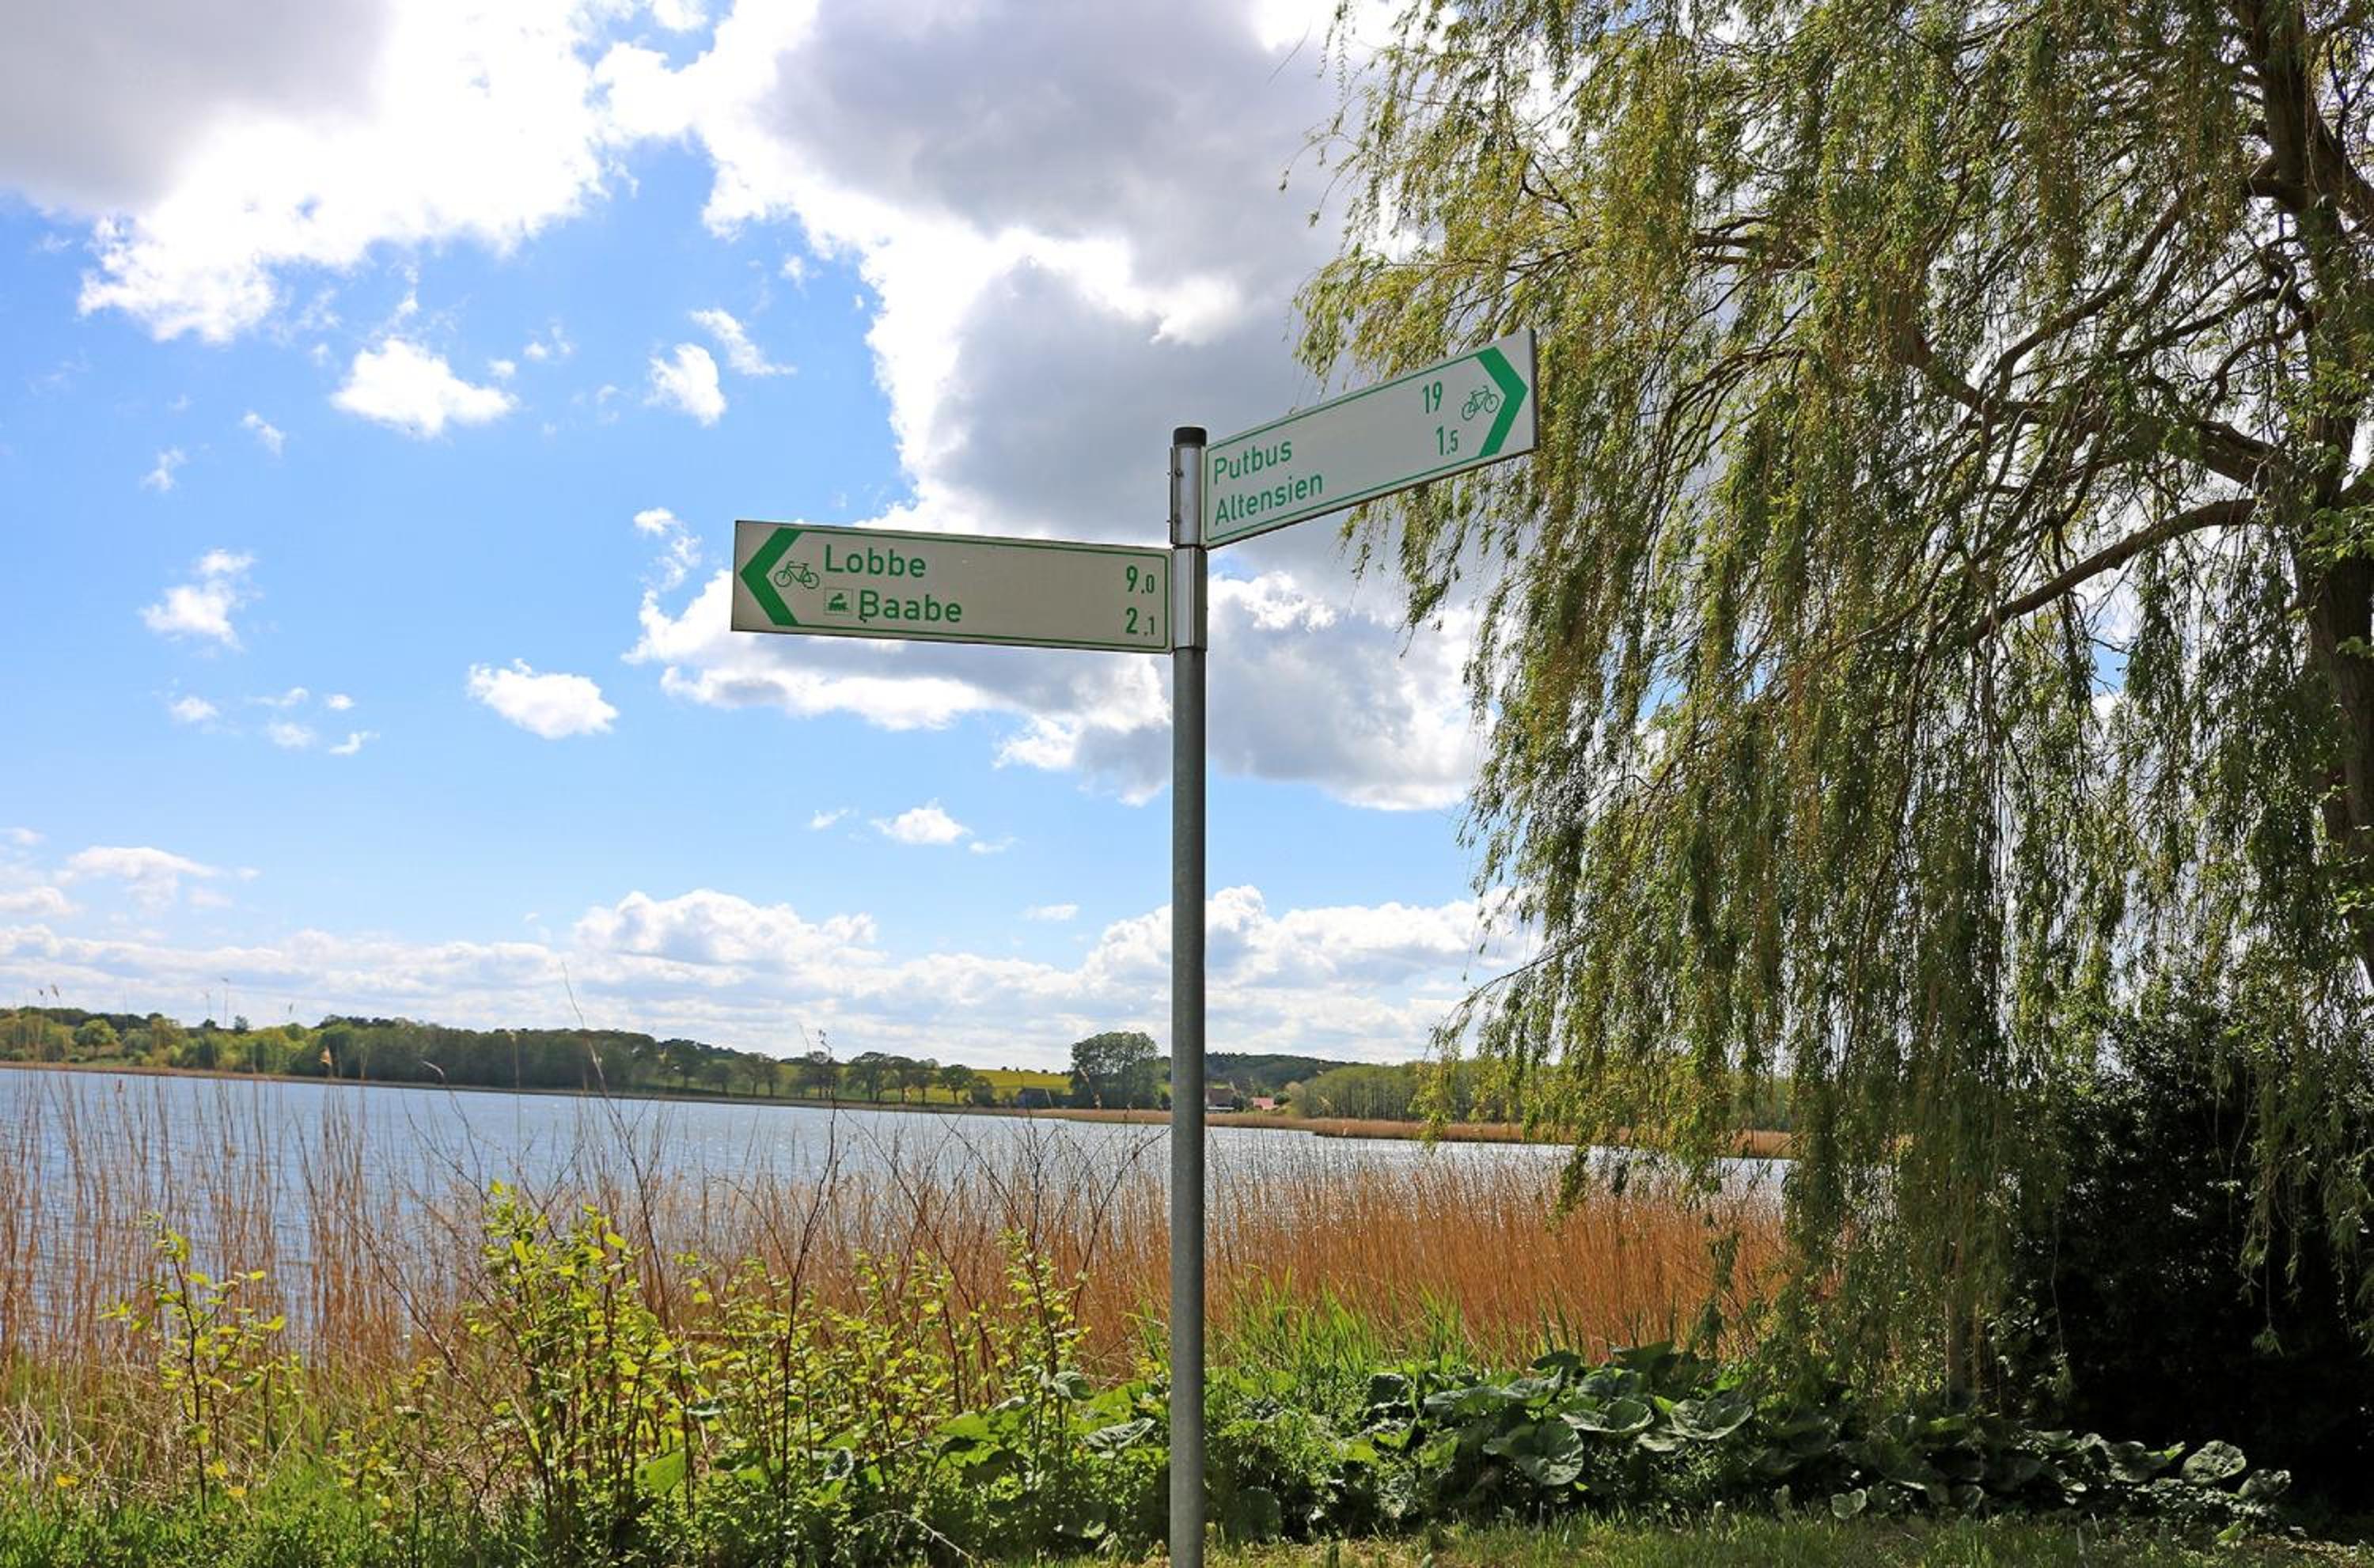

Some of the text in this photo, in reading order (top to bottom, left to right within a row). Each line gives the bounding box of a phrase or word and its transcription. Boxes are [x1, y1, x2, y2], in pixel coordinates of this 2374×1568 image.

[1214, 381, 1443, 484] Putbus 19
[1215, 426, 1459, 526] Altensien 1.5
[825, 543, 1155, 594] Lobbe 9.0
[859, 589, 1155, 636] Baabe 2.1
